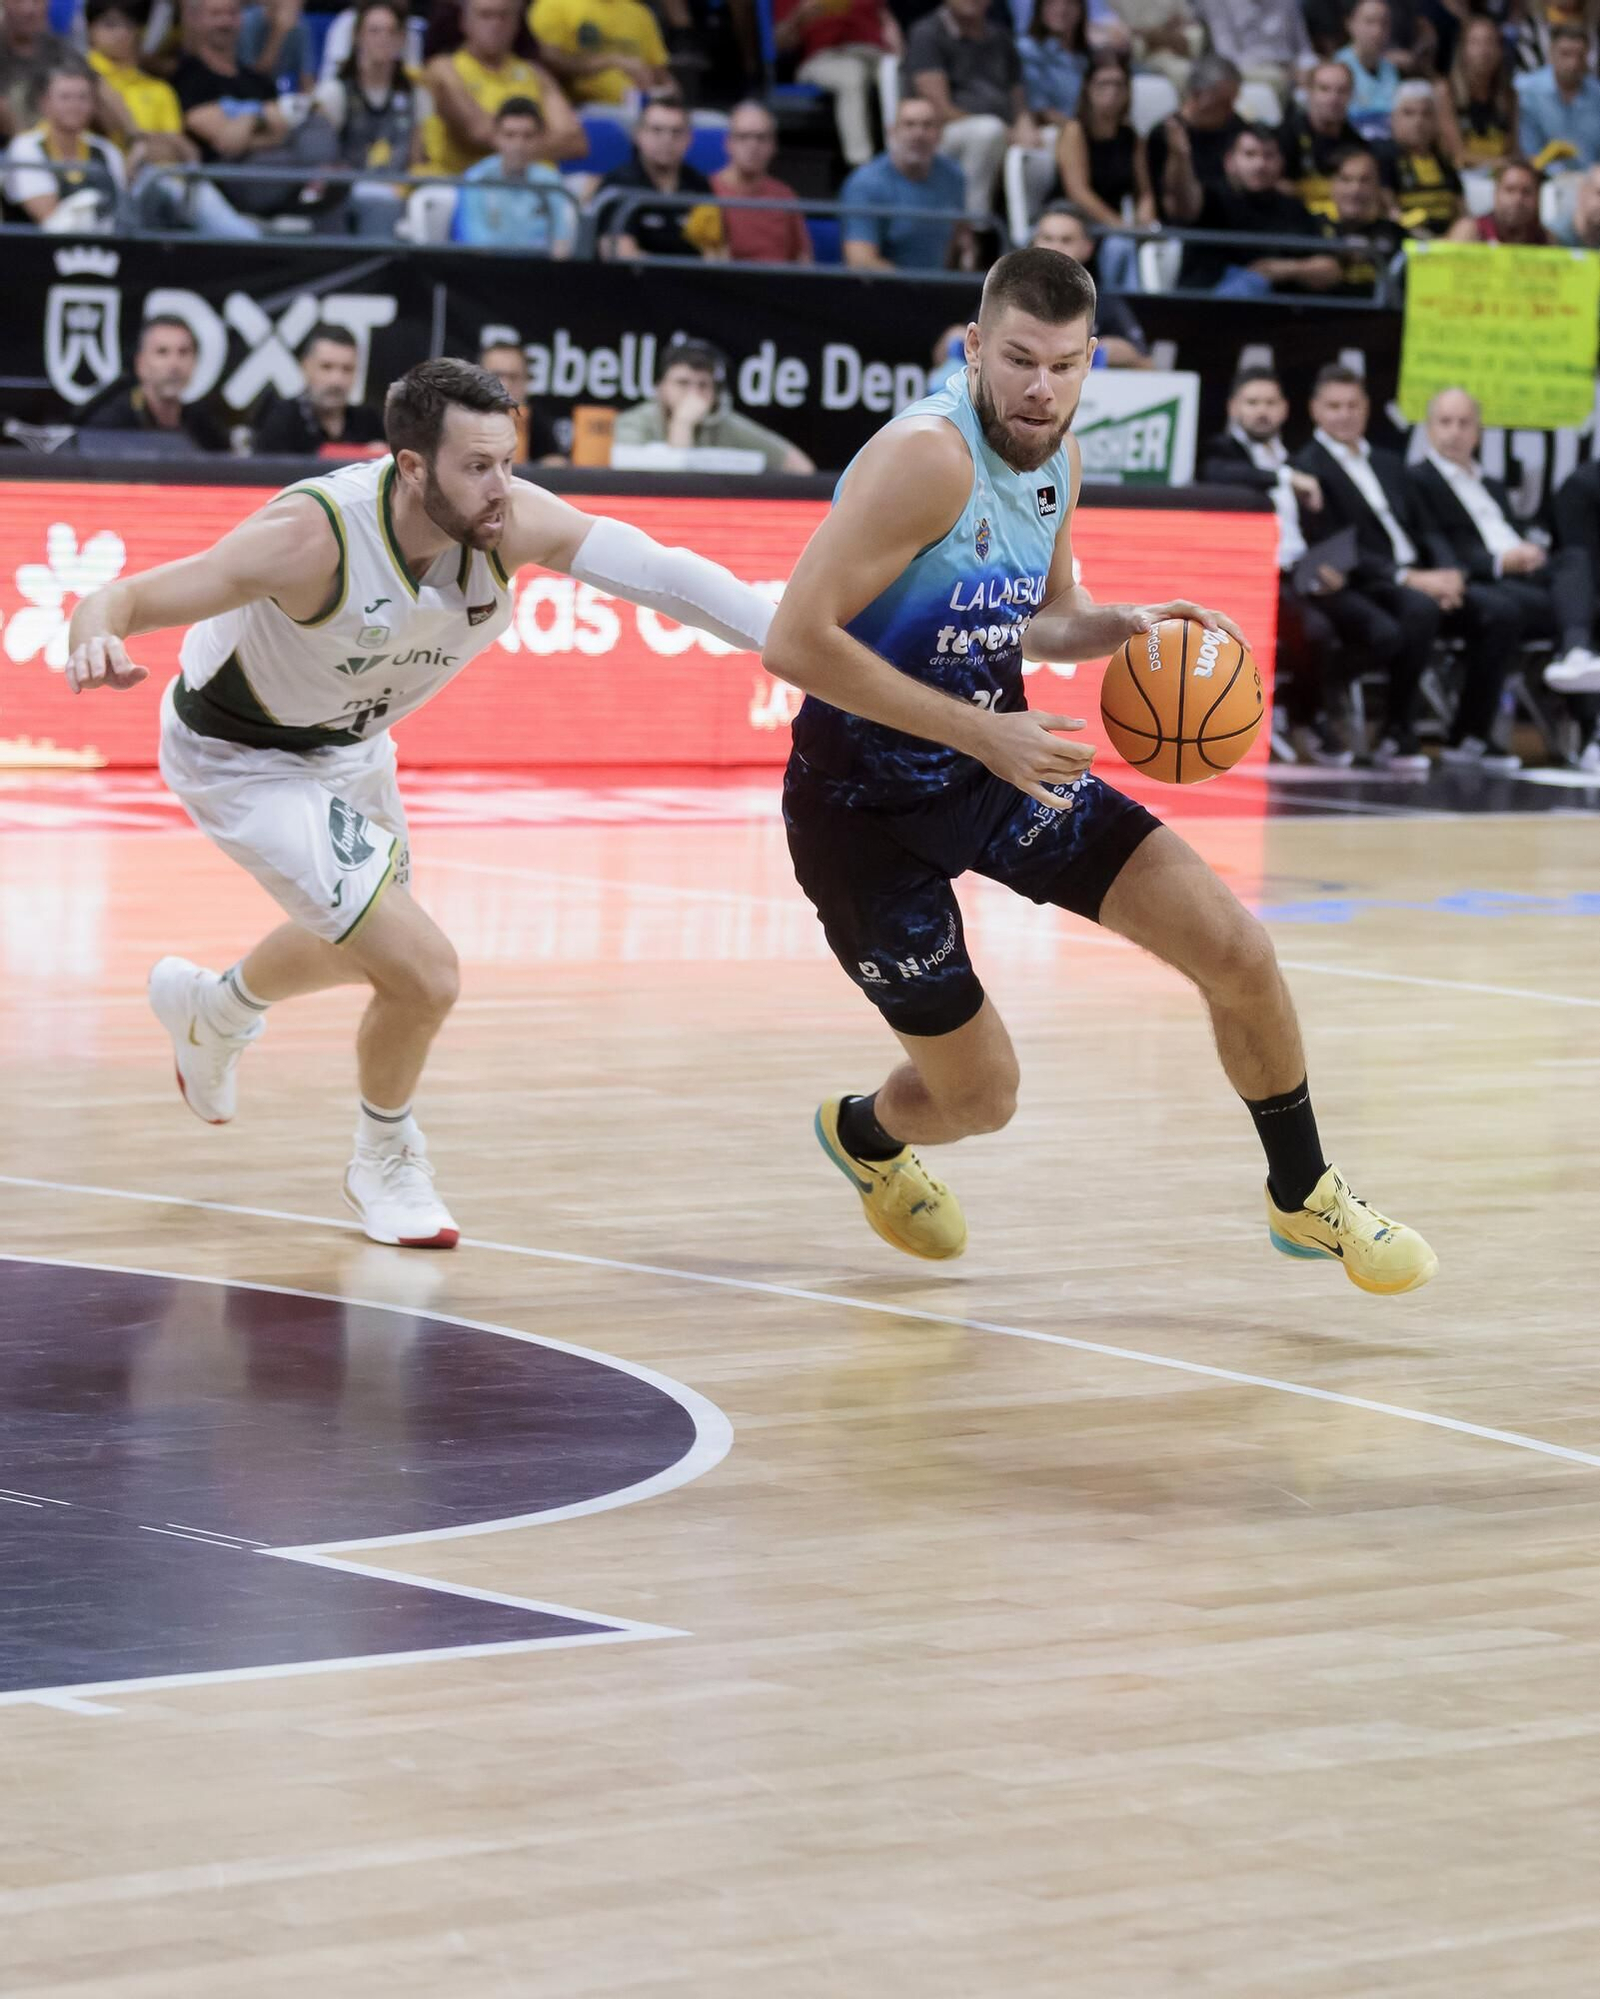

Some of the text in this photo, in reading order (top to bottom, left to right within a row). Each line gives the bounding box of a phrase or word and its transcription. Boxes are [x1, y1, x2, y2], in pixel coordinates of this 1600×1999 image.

[738, 340, 809, 405] de
[822, 342, 930, 416] Dep
[950, 581, 985, 612] LA
